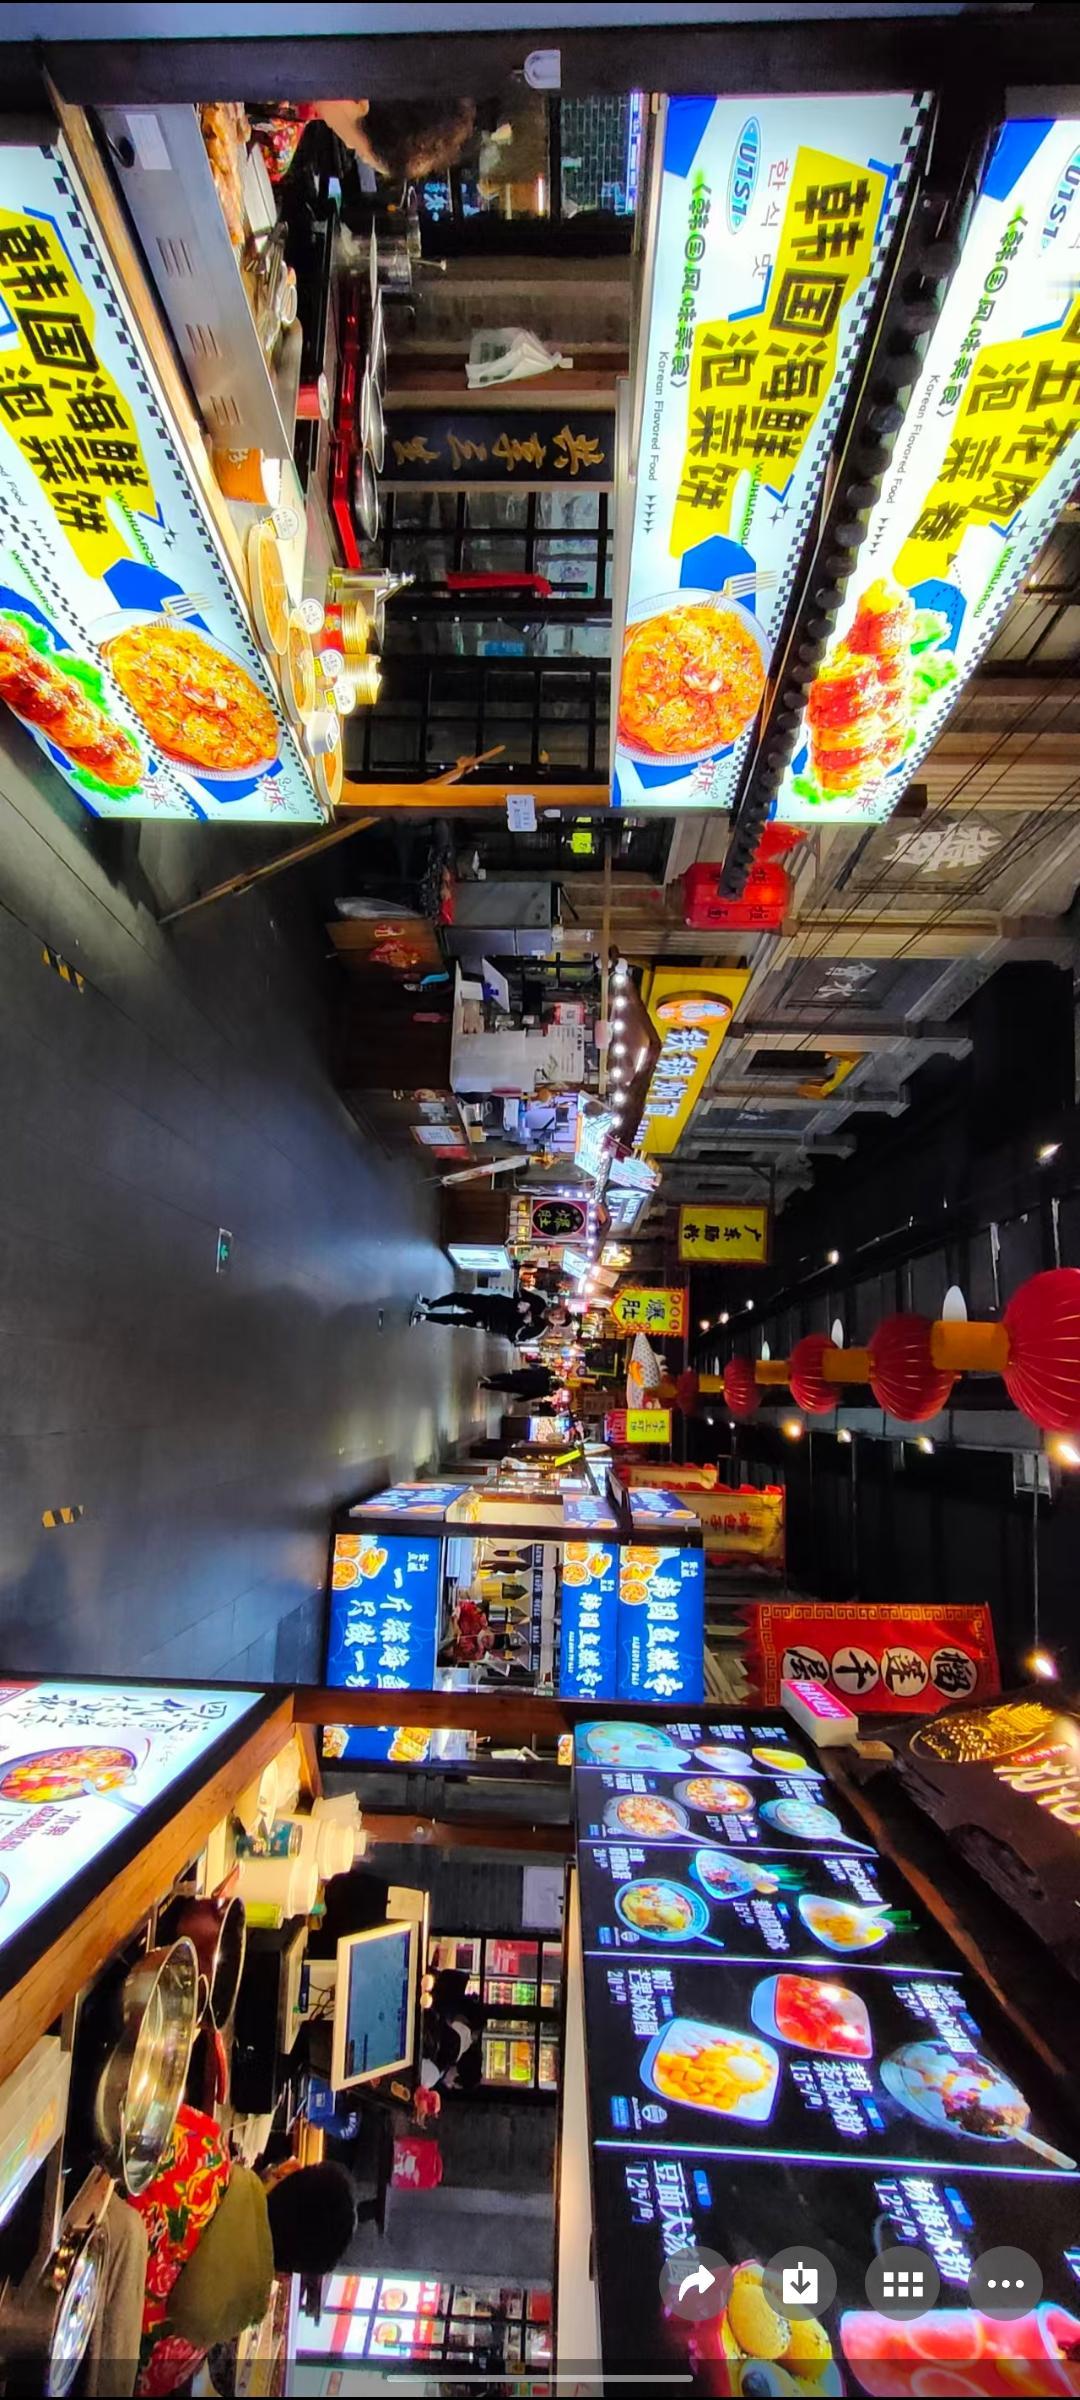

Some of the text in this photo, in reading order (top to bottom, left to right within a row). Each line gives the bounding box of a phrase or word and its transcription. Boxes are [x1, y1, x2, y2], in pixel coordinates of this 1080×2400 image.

[0, 224, 149, 487] 韩国海鲜
[742, 177, 872, 459] 韩国海鲜
[0, 365, 108, 533] 泡菜饼
[648, 350, 670, 481] Korean Flavored Food
[676, 330, 760, 509] 泡菜饼
[885, 374, 942, 504] Korean Flavored Food
[907, 362, 1031, 542] 泡菜卷
[968, 319, 1080, 518] 五花肉
[114, 489, 160, 569] WUHUAROU
[741, 462, 765, 546] WUHUAROU
[11, 550, 59, 619] WUHUAROU
[973, 545, 1018, 619] WUHUAROU
[643, 1029, 710, 1118] 铁锅焖面
[683, 1222, 763, 1243] 广东肠粉
[643, 1575, 683, 1702] 韩国鱼糕专
[628, 1970, 660, 2036] 芒果冰汤圆
[900, 2177, 973, 2284] 杨梅冰粉
